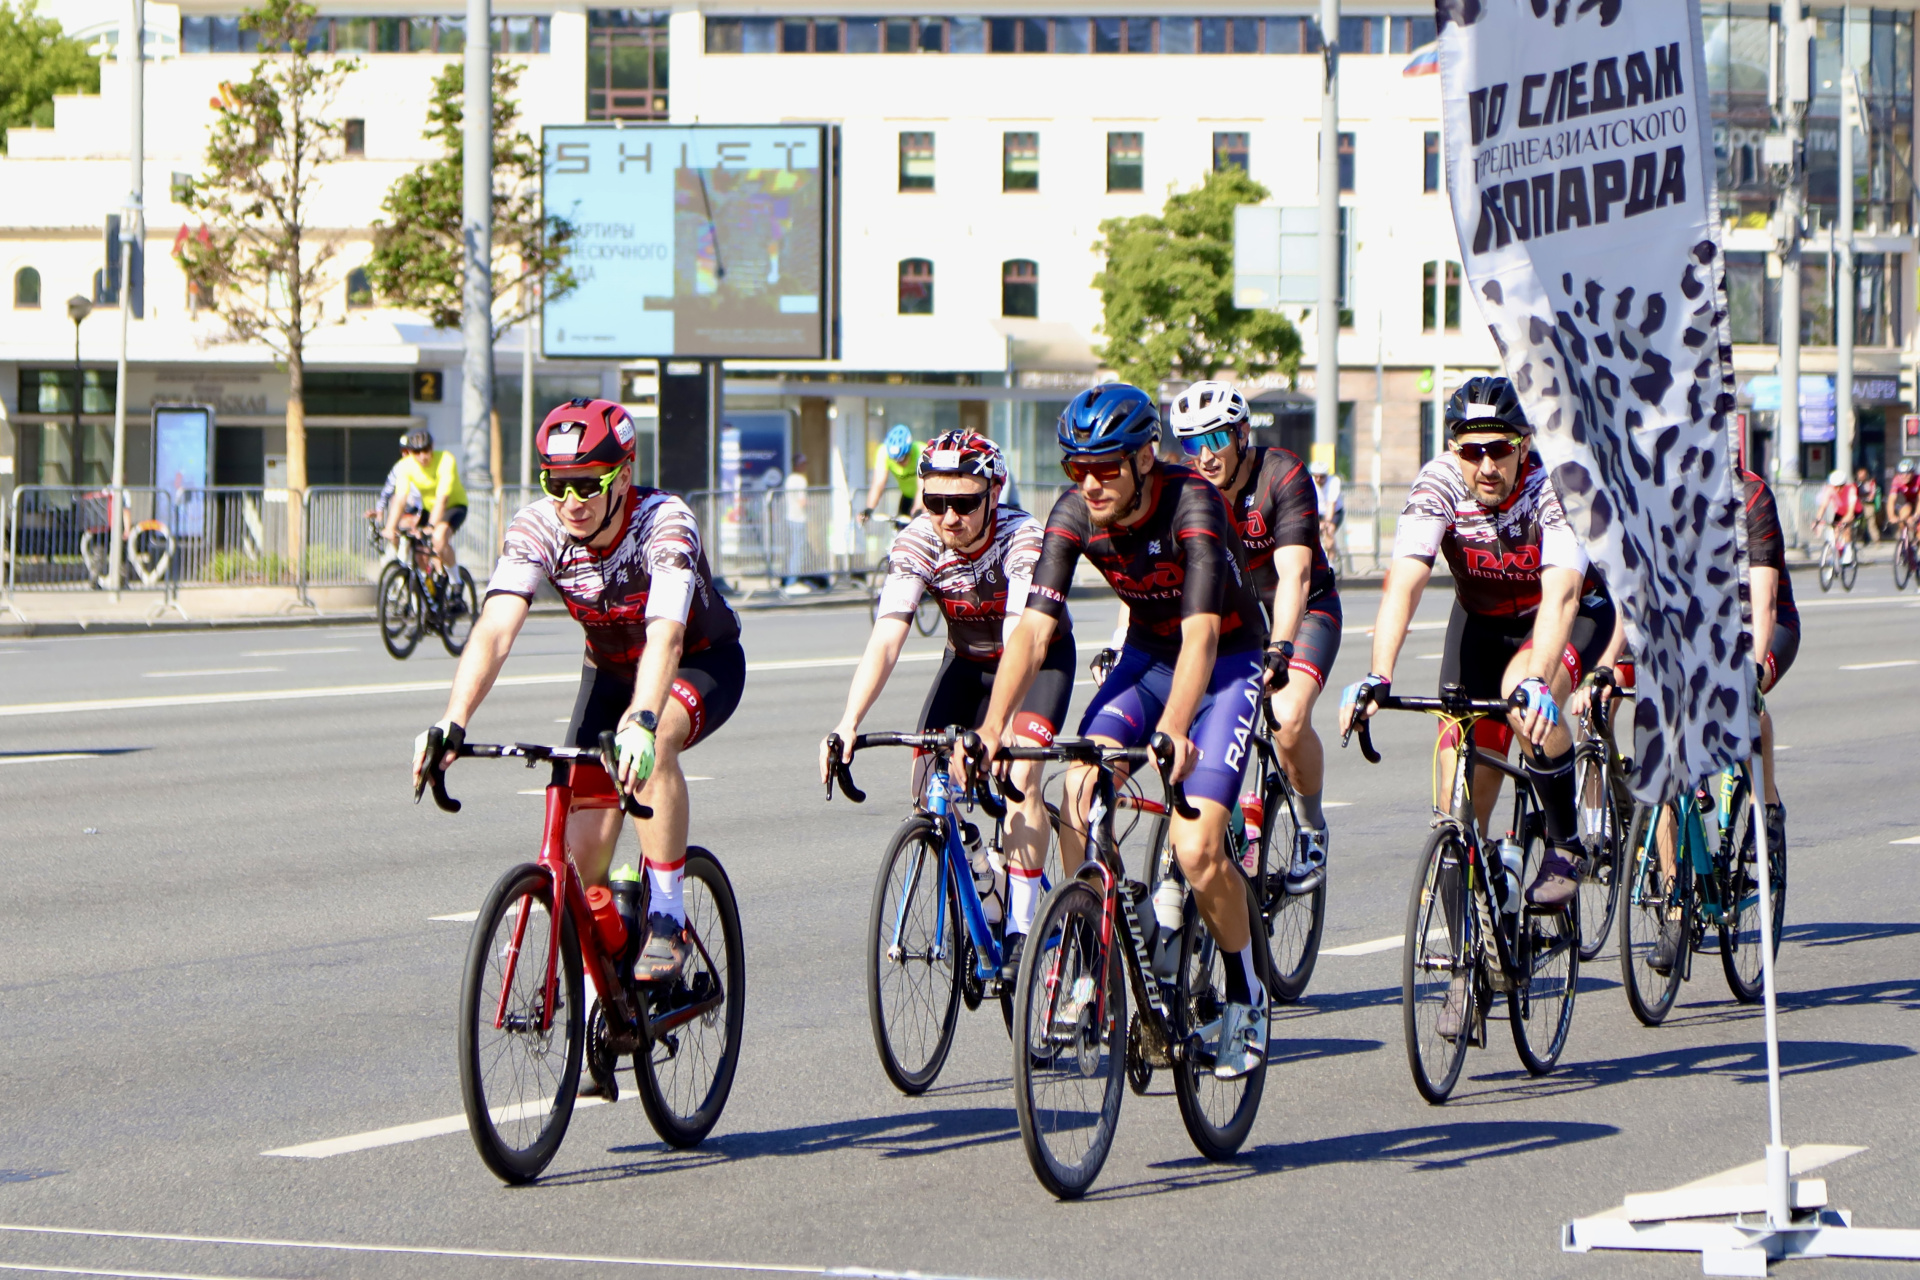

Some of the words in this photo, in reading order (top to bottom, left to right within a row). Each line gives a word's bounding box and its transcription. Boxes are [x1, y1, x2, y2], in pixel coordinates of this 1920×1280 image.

[1518, 42, 1684, 129] СЛЕДАМ
[1473, 106, 1687, 184] РЕДНЕАЗИАТСКОГО
[421, 373, 436, 398] 2
[1851, 380, 1898, 399] АЛЕРЕЯ
[1468, 568, 1504, 581] IRON
[1153, 589, 1182, 599] TEA
[671, 682, 697, 707] RZD
[1028, 721, 1053, 742] RZD
